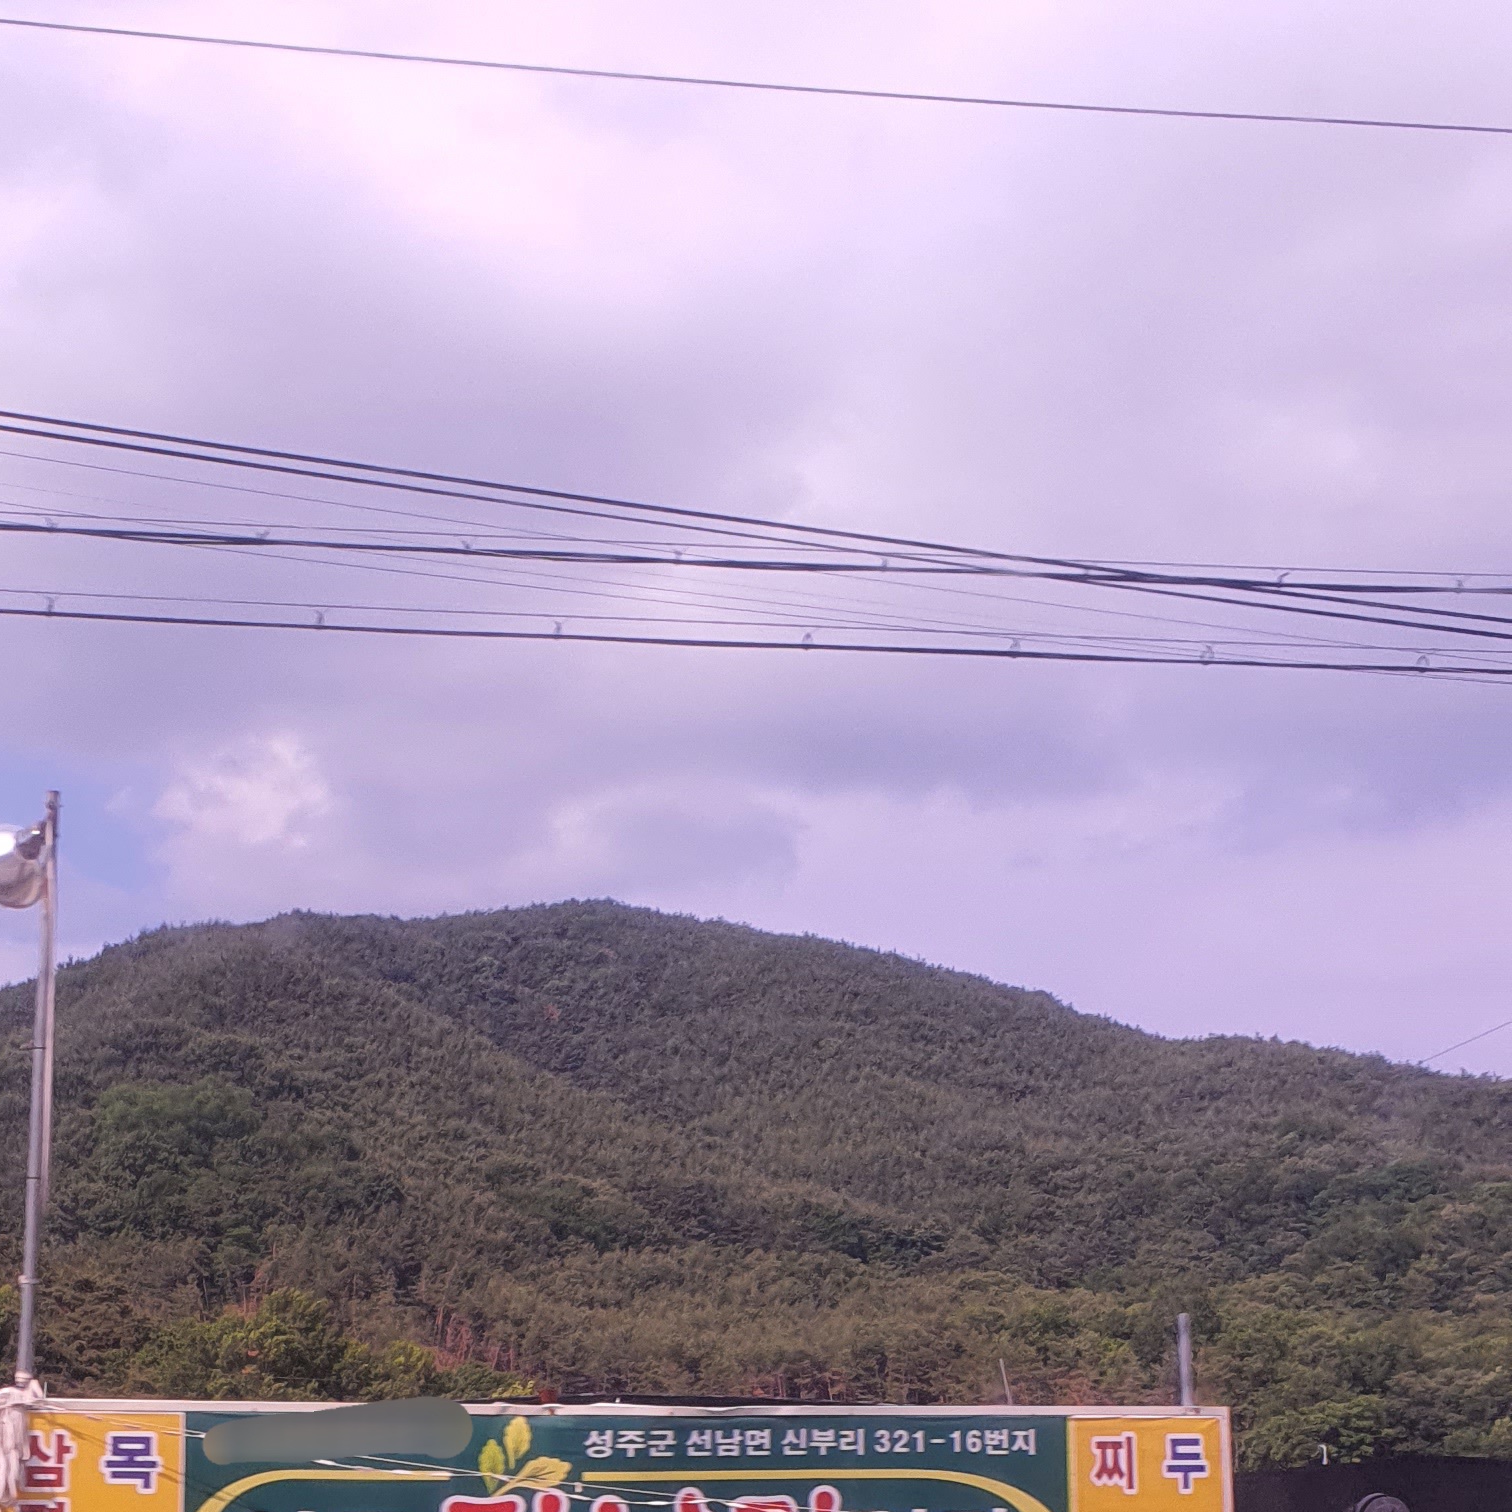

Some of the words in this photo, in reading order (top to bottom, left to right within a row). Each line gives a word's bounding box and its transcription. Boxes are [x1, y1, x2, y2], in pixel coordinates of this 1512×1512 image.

[583, 1429, 677, 1458] 성주군
[685, 1429, 772, 1457] 선남면
[781, 1428, 865, 1456] 신부리
[873, 1428, 1037, 1456] 321-16번지
